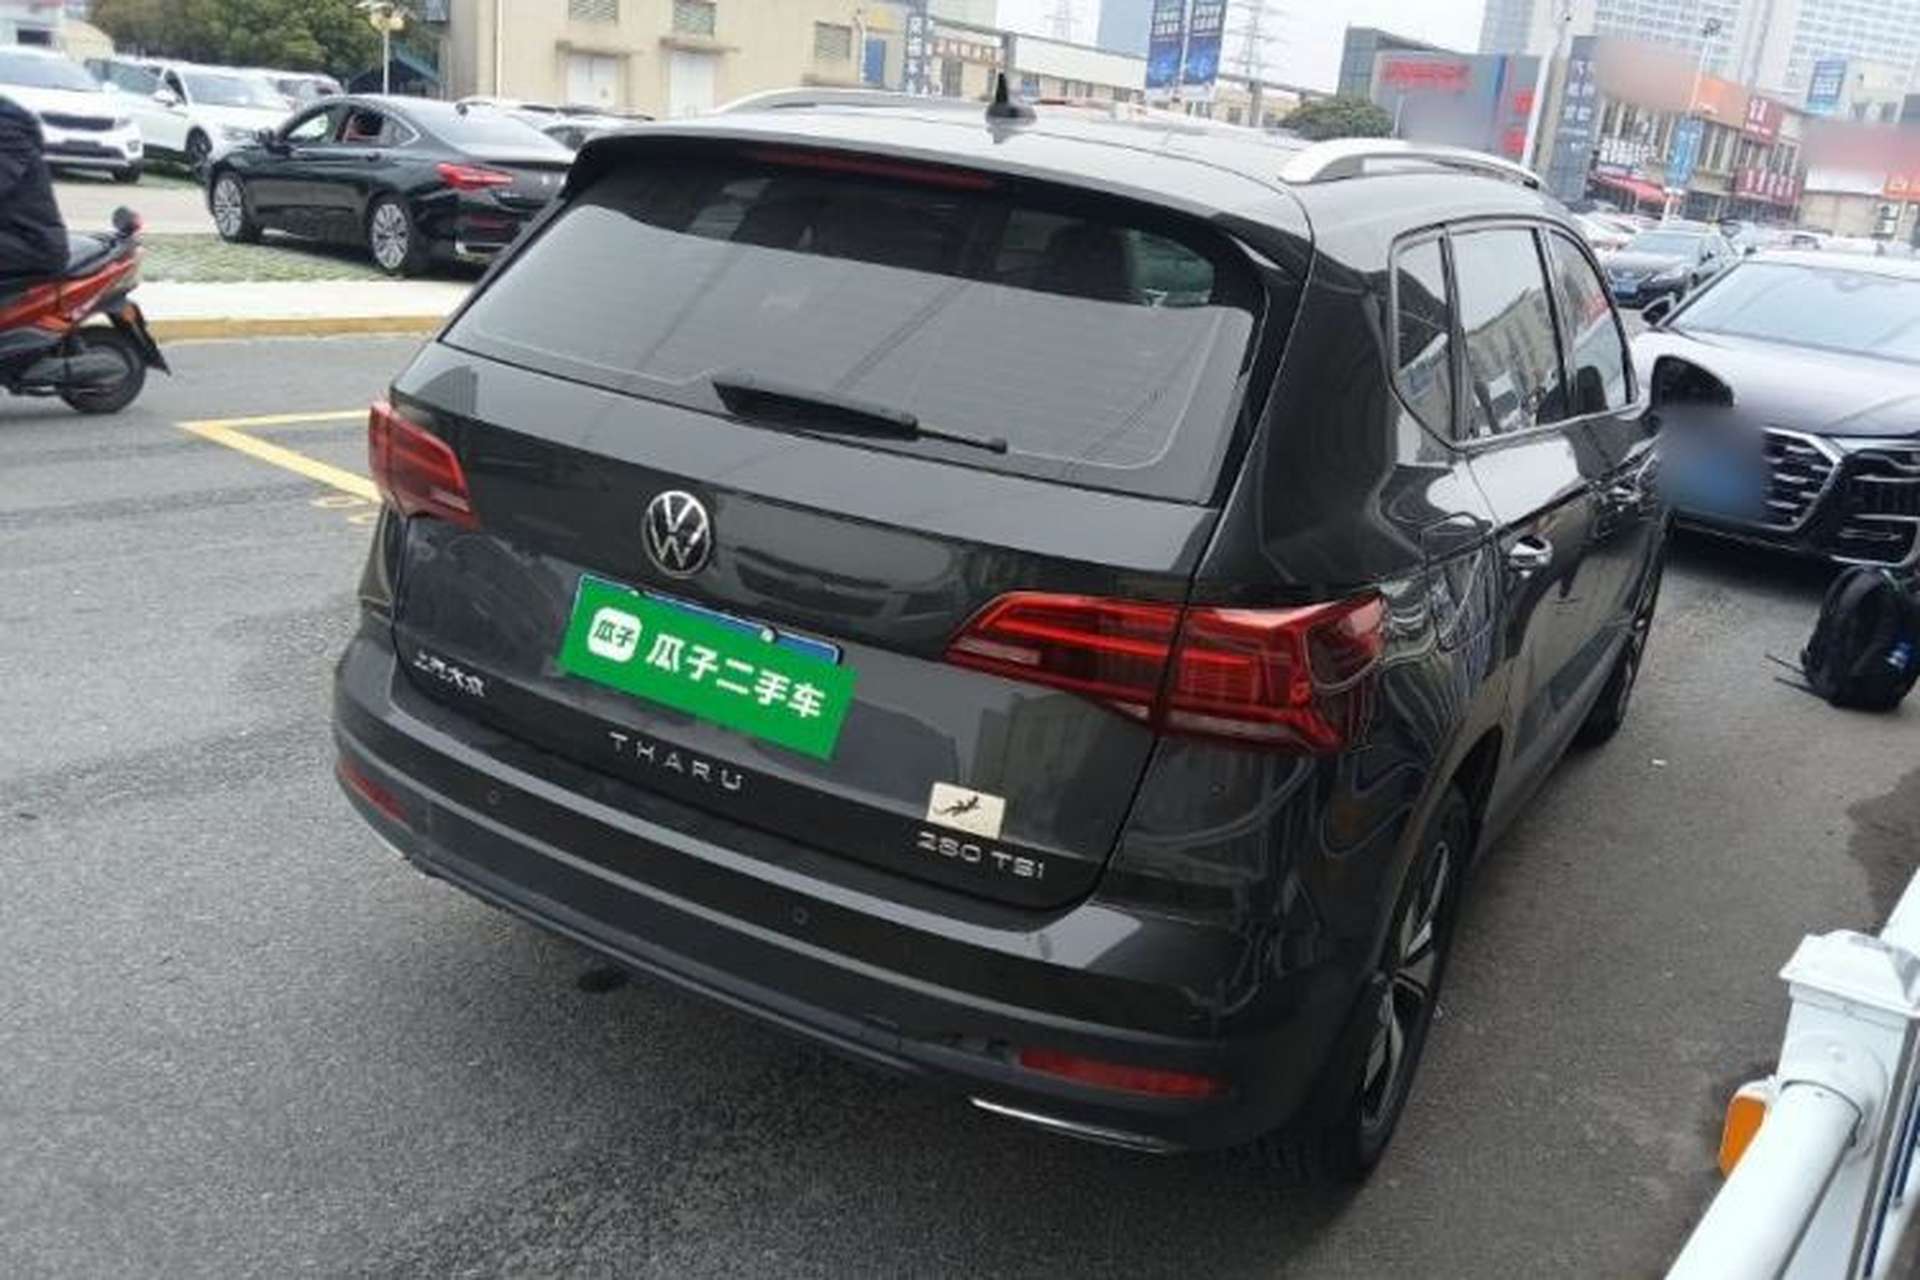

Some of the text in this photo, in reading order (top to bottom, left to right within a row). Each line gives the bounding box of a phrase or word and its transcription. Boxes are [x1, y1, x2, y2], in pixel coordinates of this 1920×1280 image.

[413, 649, 485, 698] 上汽大众
[608, 731, 744, 791] THARU
[916, 830, 982, 863] 280
